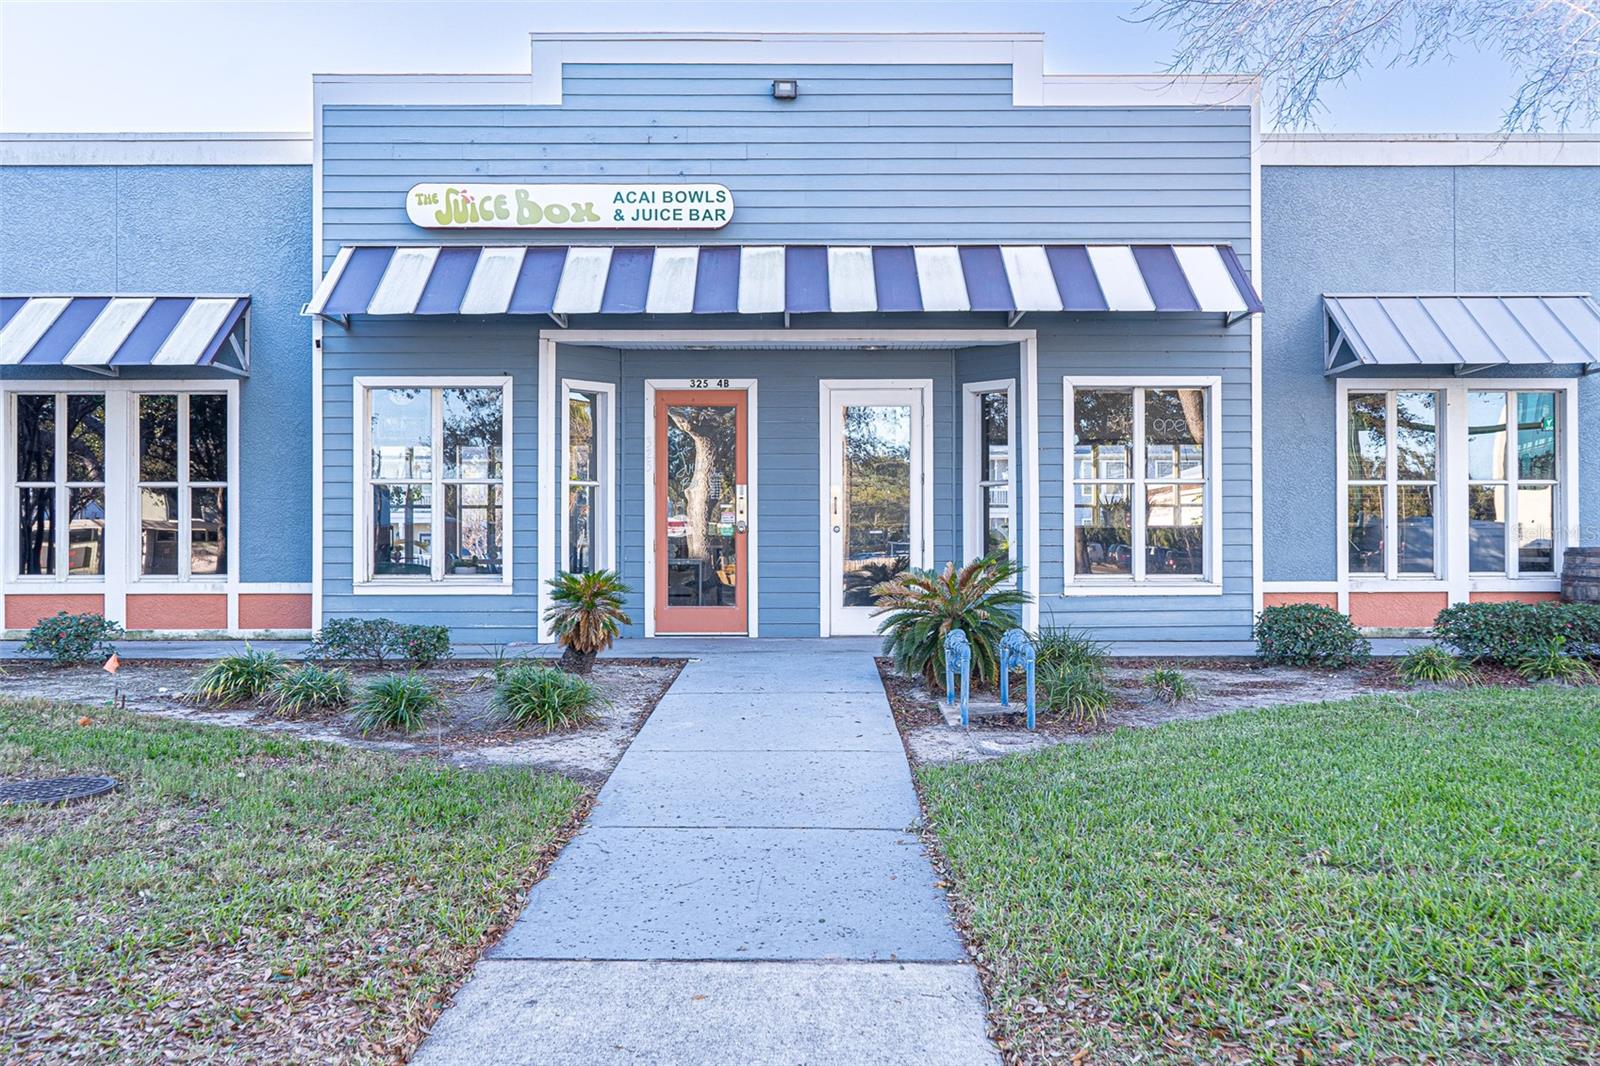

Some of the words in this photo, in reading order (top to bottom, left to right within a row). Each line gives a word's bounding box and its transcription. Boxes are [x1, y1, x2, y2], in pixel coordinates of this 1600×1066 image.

[415, 192, 439, 205] THE
[613, 191, 655, 204] ACAI
[662, 190, 727, 204] BOWLS
[613, 208, 625, 221] &
[631, 208, 683, 222] JUICE
[689, 208, 727, 222] BAR
[689, 379, 709, 388] 325
[716, 379, 730, 388] 4B
